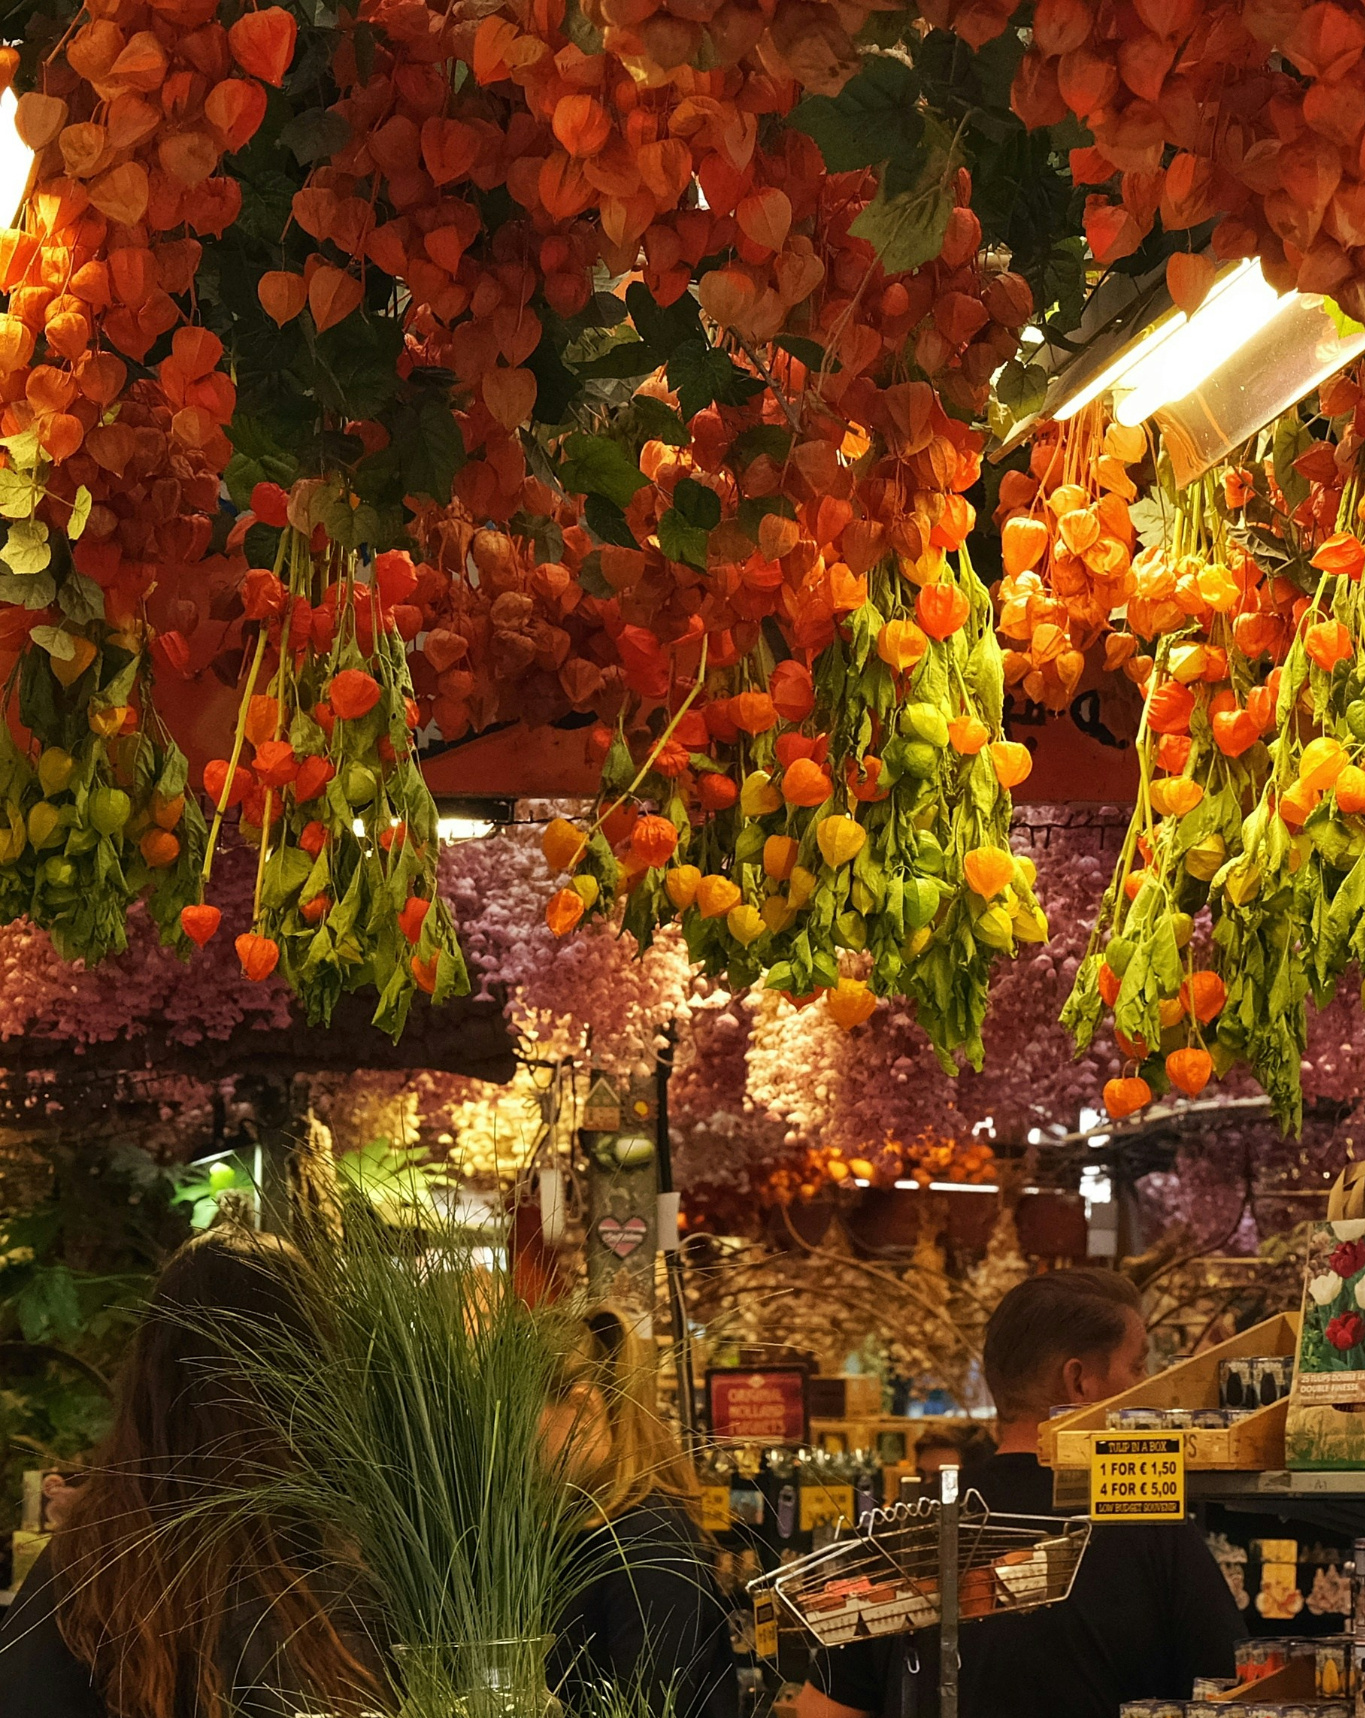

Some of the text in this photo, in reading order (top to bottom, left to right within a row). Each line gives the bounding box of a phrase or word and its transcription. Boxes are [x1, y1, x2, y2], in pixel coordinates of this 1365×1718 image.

[1108, 1441, 1167, 1453] TULIP IN A BOX
[1100, 1461, 1176, 1478] 1 FOR € 1,50
[1100, 1481, 1177, 1498] 4 FOR € 5,00
